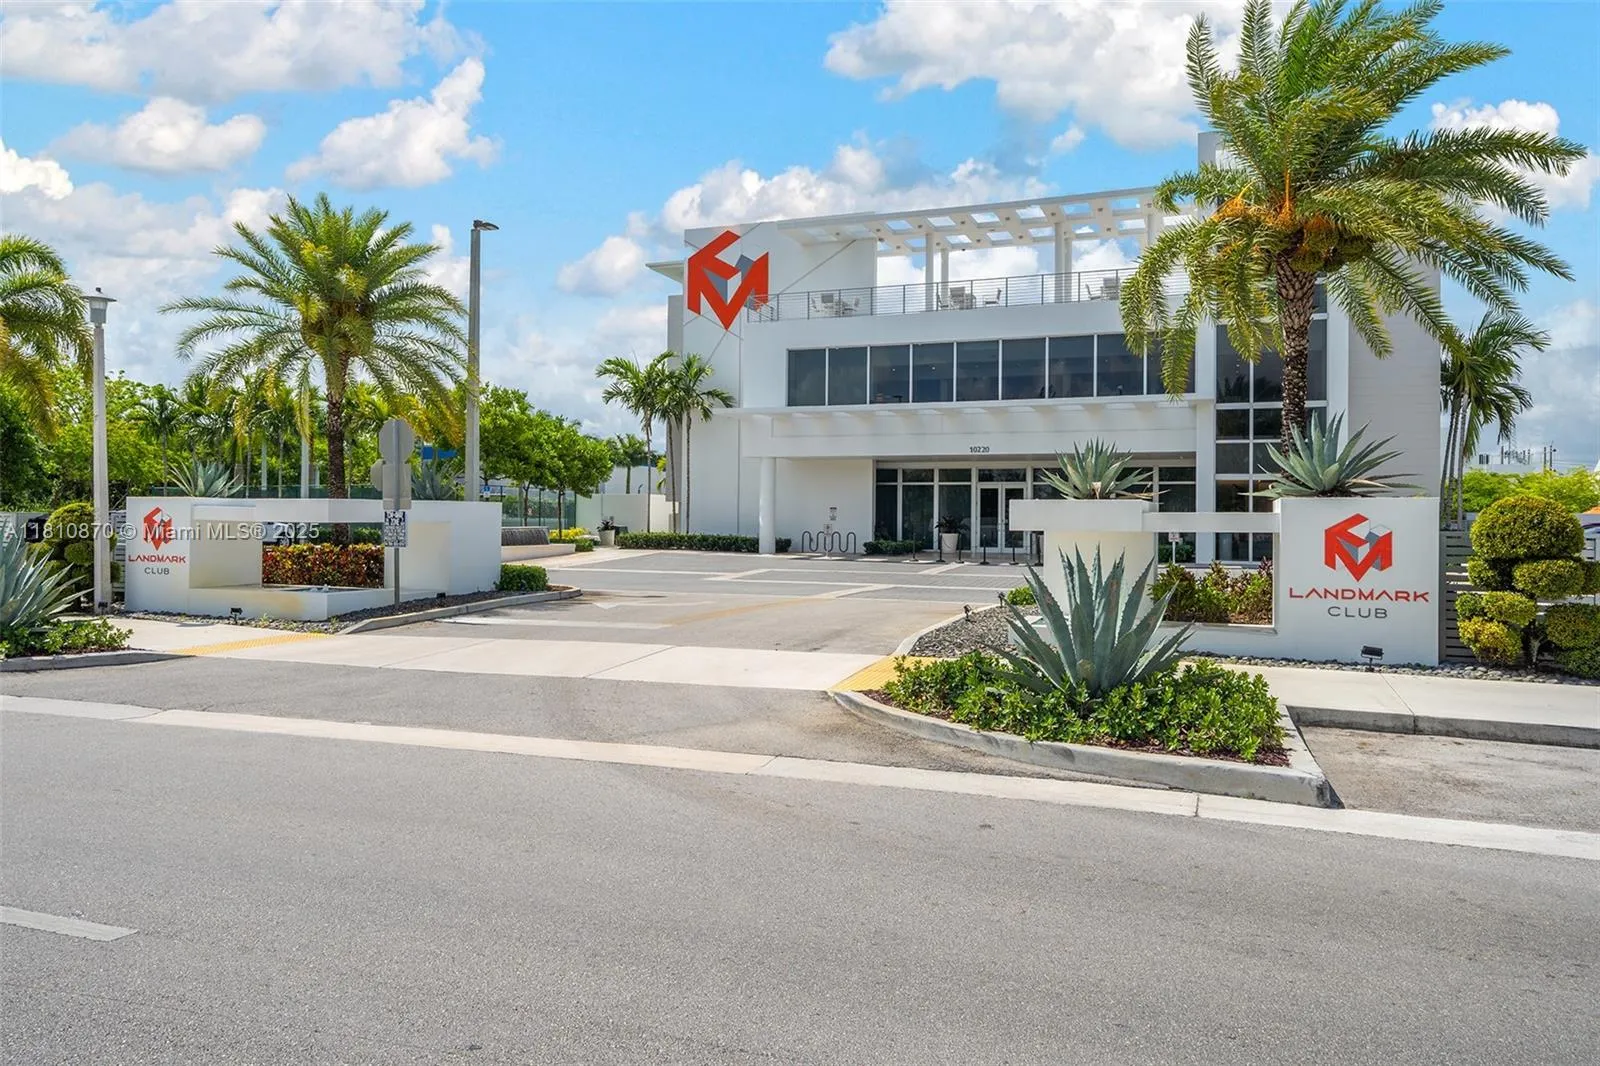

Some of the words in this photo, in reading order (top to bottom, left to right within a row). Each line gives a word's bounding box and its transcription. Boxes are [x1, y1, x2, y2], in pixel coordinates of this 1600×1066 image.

[128, 554, 186, 563] LANDMARK
[144, 566, 170, 575] CLUB
[1289, 587, 1429, 602] LANDMARK
[1328, 606, 1388, 619] CLUB
